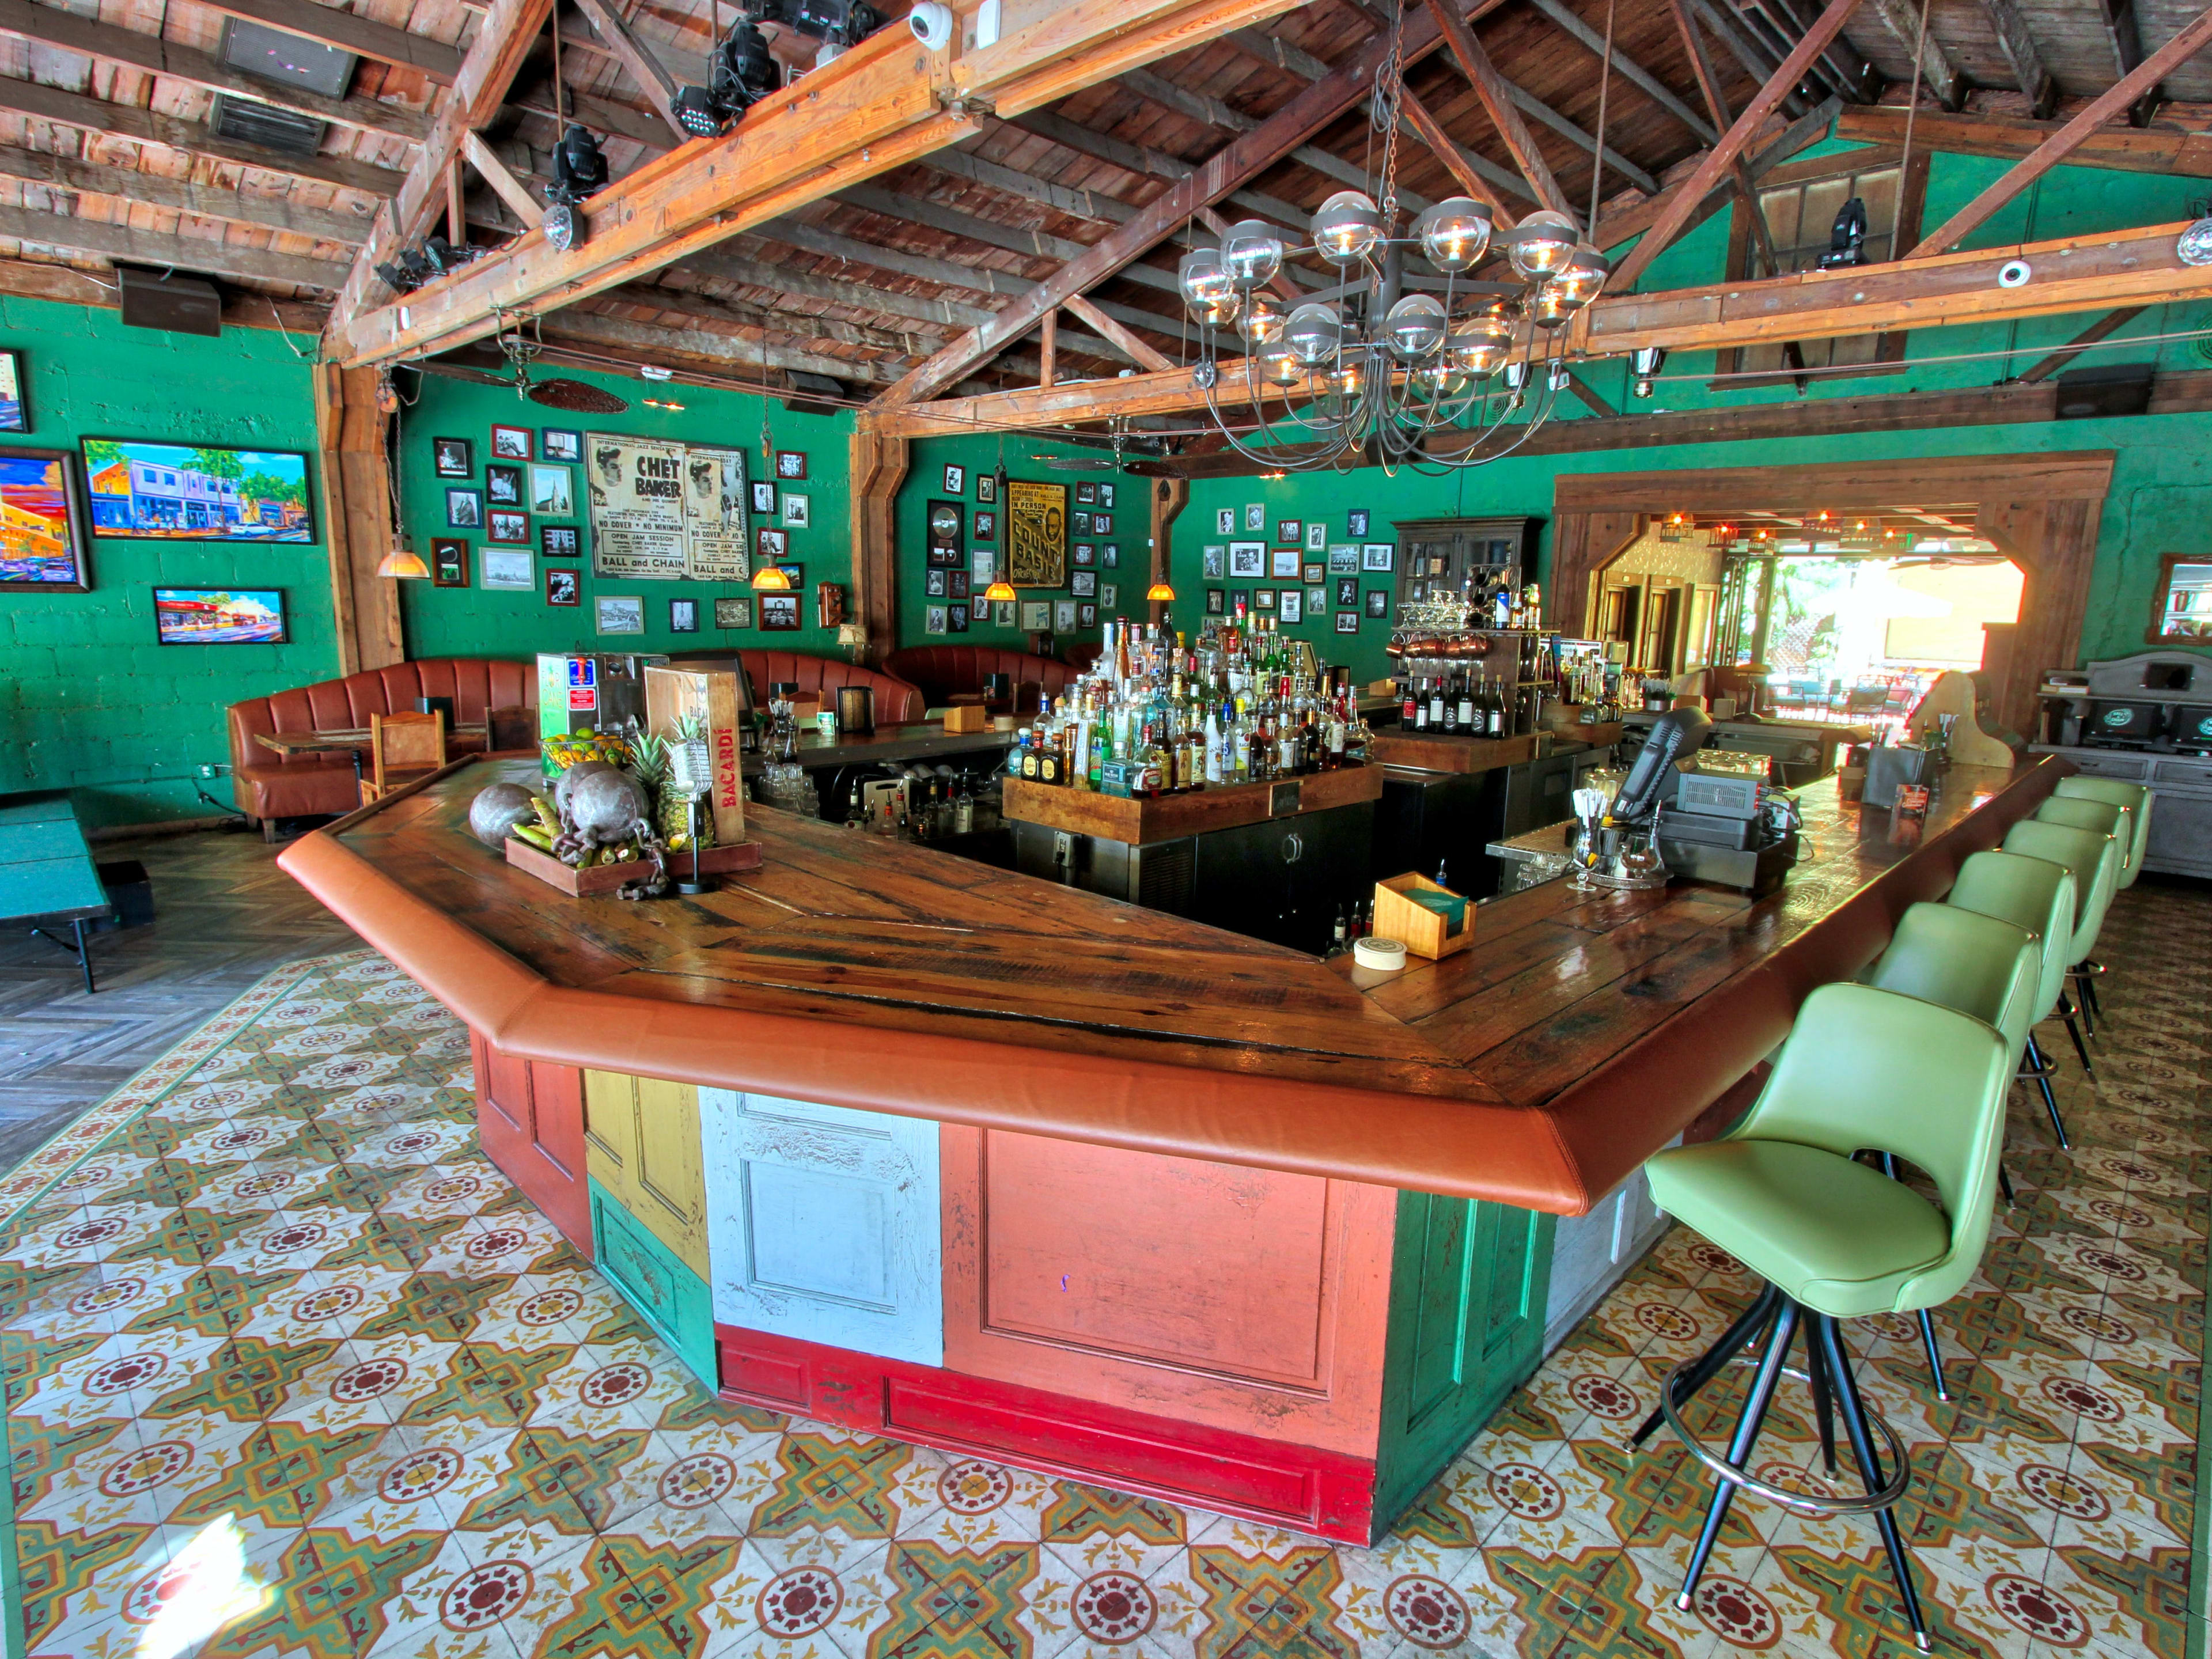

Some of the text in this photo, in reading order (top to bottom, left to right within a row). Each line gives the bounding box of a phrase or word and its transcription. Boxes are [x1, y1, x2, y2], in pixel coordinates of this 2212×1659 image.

[637, 456, 680, 479] CHET
[635, 478, 682, 498] BAKER
[611, 520, 632, 529] COVER
[655, 524, 683, 532] MINIMUM
[1014, 518, 1059, 563] COUNT
[602, 556, 685, 568] BALL and CHAIN
[694, 565, 716, 573] BALL
[1017, 540, 1056, 580] BASIE
[713, 728, 737, 808] BACARDÍ
